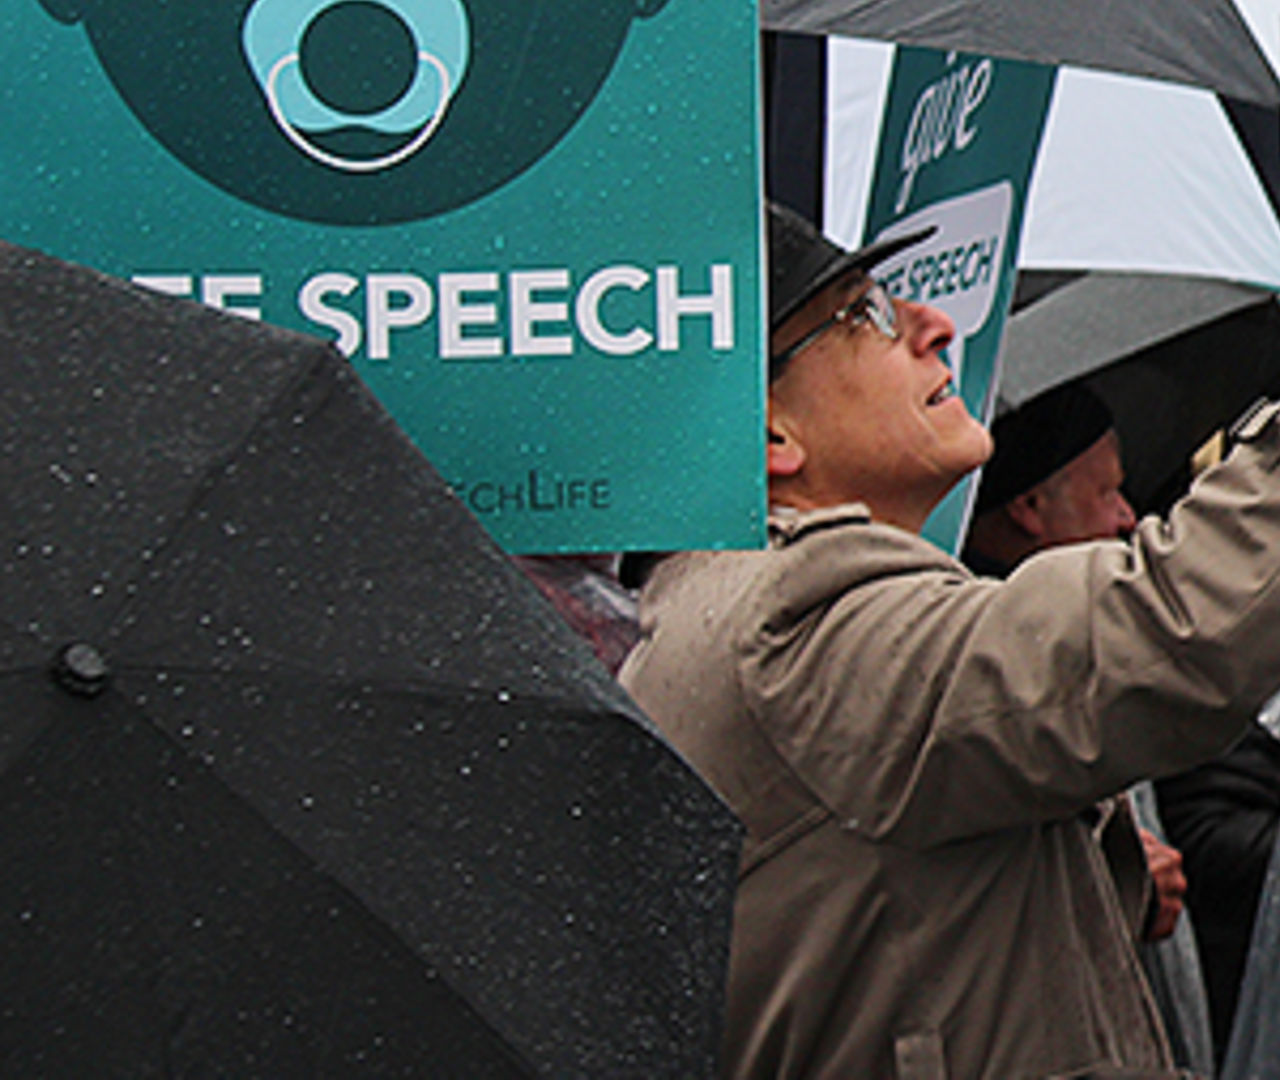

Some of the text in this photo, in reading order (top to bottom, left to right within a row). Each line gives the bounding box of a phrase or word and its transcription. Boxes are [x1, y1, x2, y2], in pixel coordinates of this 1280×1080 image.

[895, 50, 993, 215] give
[300, 264, 735, 361] SPEECH
[906, 236, 998, 300] SPEECH
